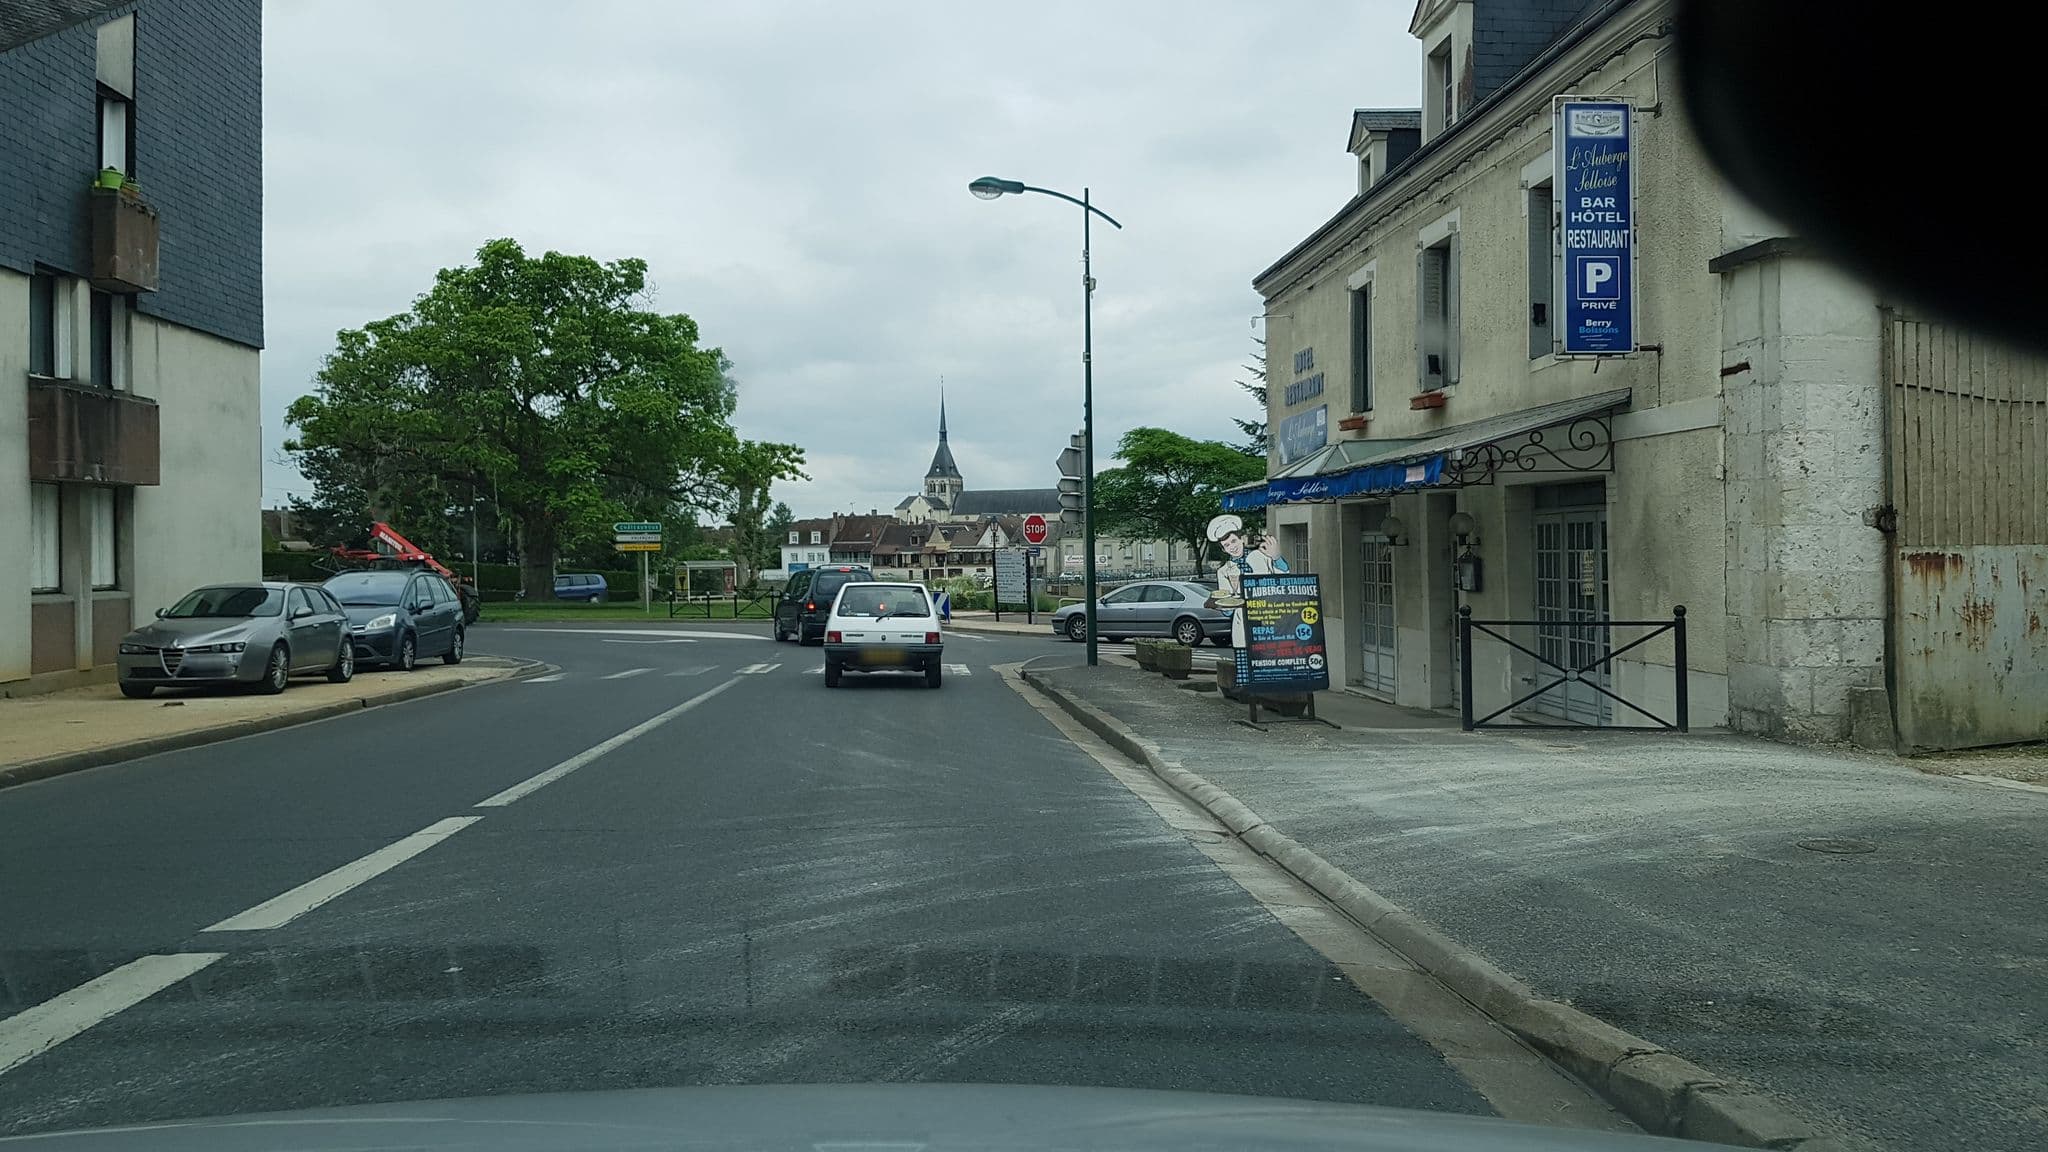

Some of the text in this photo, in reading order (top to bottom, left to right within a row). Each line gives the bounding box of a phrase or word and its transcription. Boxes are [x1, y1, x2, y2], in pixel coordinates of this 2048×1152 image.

[1566, 143, 1629, 172] L'Auberge
[1575, 168, 1618, 193] Selloise
[1581, 197, 1616, 208] BAR
[1571, 209, 1626, 223] HÔTEL
[1567, 229, 1629, 249] RESTAURANT
[1586, 262, 1612, 293] P
[1581, 301, 1617, 310] PRIVÉ
[1585, 319, 1612, 328] Berry
[1579, 326, 1619, 334] Boissons
[1026, 524, 1045, 534] STOP
[1243, 579, 1256, 587] BAR
[1279, 576, 1317, 586] RESTAURANT
[1243, 585, 1318, 599] L'AUBERGE SELLOISE
[1246, 600, 1266, 608] MENU
[1252, 626, 1275, 635] REPAS
[1251, 659, 1277, 667] PENSION
